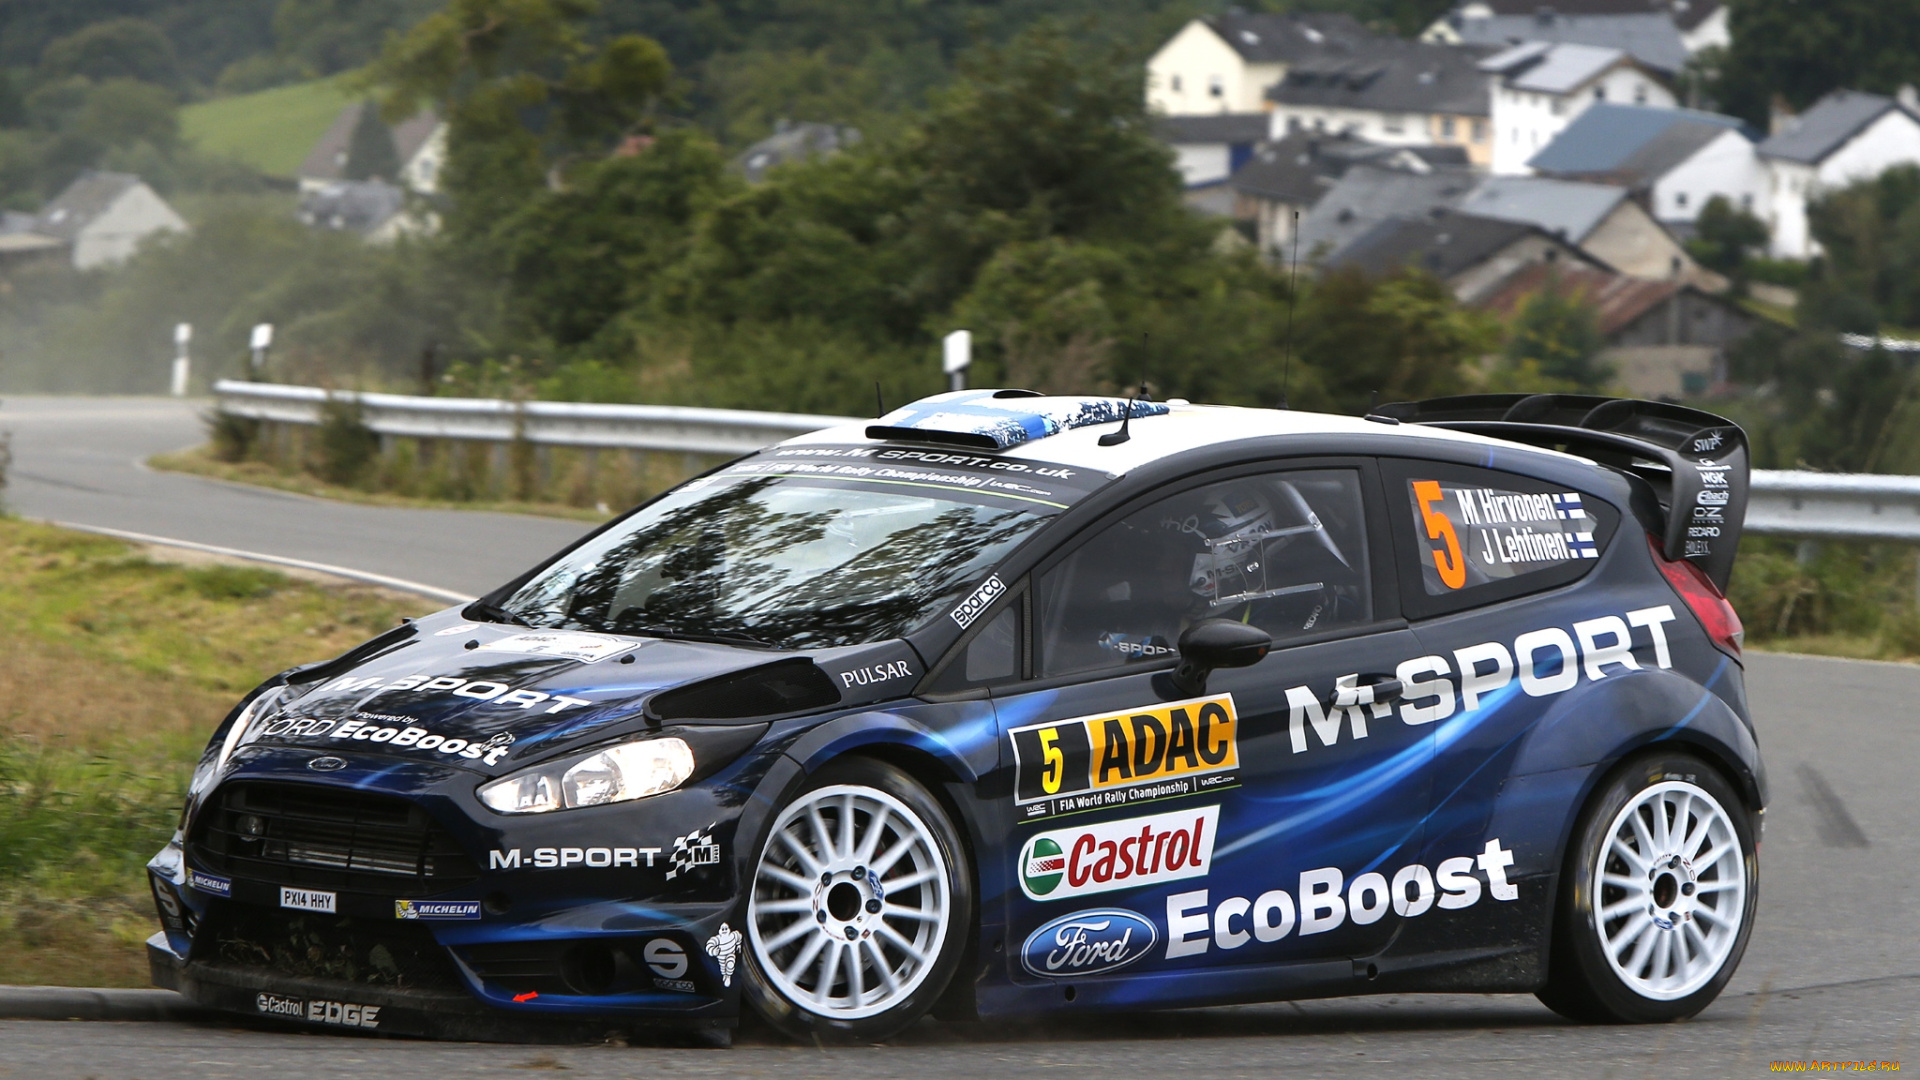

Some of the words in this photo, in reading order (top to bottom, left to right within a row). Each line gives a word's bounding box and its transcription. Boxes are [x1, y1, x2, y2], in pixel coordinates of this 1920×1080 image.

[794, 464, 838, 474] World
[875, 468, 982, 488] Championship
[1700, 472, 1728, 484] NGK
[1693, 507, 1723, 518] OZ
[1412, 480, 1467, 590] 5
[1454, 489, 1481, 525] M
[1477, 488, 1557, 524] Hirvonen
[1480, 528, 1495, 565] J
[1494, 526, 1570, 563] Lehtinen
[1688, 527, 1721, 537] RECARO
[954, 577, 1002, 627] sparco
[840, 660, 912, 689] PULSAR
[1285, 605, 1677, 753] M-SPORT
[324, 675, 592, 714] M-SPORT
[356, 711, 404, 723] Powered
[404, 715, 419, 725] by
[330, 721, 509, 767] EcoBoost
[1038, 727, 1064, 795] 5
[1099, 702, 1230, 783] ADAC
[1060, 800, 1075, 812] FIA
[1077, 795, 1102, 808] World
[1105, 792, 1127, 805] Rally
[1129, 781, 1189, 800] Championship
[489, 847, 662, 870] M-SPORT
[1068, 815, 1206, 888] Castrol
[194, 876, 231, 891] MICHELIN
[1165, 837, 1519, 960] EcoBoost
[284, 890, 307, 907] PX14
[311, 893, 332, 910] HHY
[418, 904, 478, 916] MICHELIN
[1045, 919, 1131, 968] Ford
[267, 995, 303, 1017] Castrol
[307, 1001, 381, 1028] EDGE
